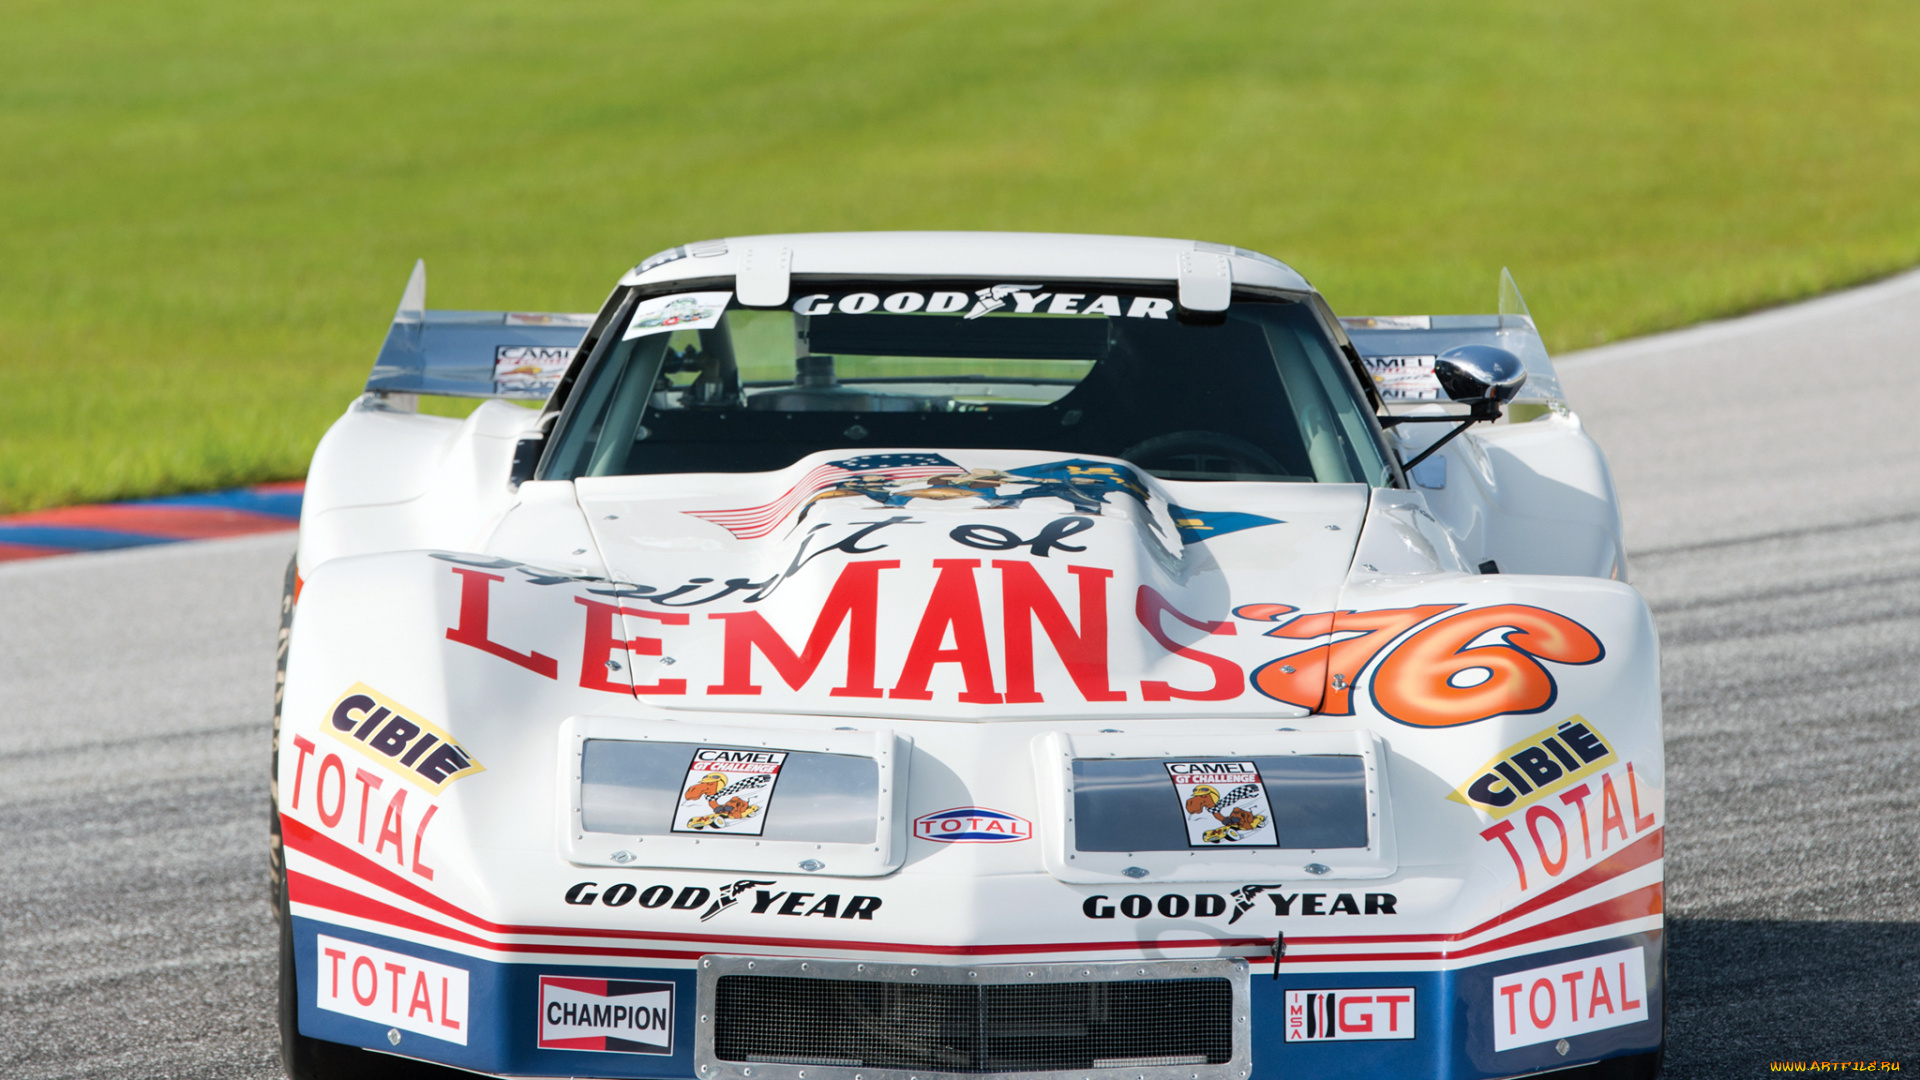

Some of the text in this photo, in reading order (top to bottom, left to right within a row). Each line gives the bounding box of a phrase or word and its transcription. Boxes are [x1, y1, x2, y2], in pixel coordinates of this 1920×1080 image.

[501, 347, 570, 358] CAM
[693, 762, 778, 773] GT CHALLENGE
[698, 750, 780, 764] CAMEL
[1170, 763, 1254, 774] CAMEL
[1467, 721, 1610, 808] CIBIÉ
[1175, 774, 1256, 784] GT CHALLENGE
[292, 733, 439, 881] TOTAL
[919, 818, 1027, 836] TOTAL
[1479, 761, 1656, 892] TOTAL
[324, 947, 461, 1031] TOTAL
[1500, 961, 1641, 1036] TOTAL
[546, 1001, 667, 1031] CHAMPION
[1338, 995, 1411, 1033] GT
